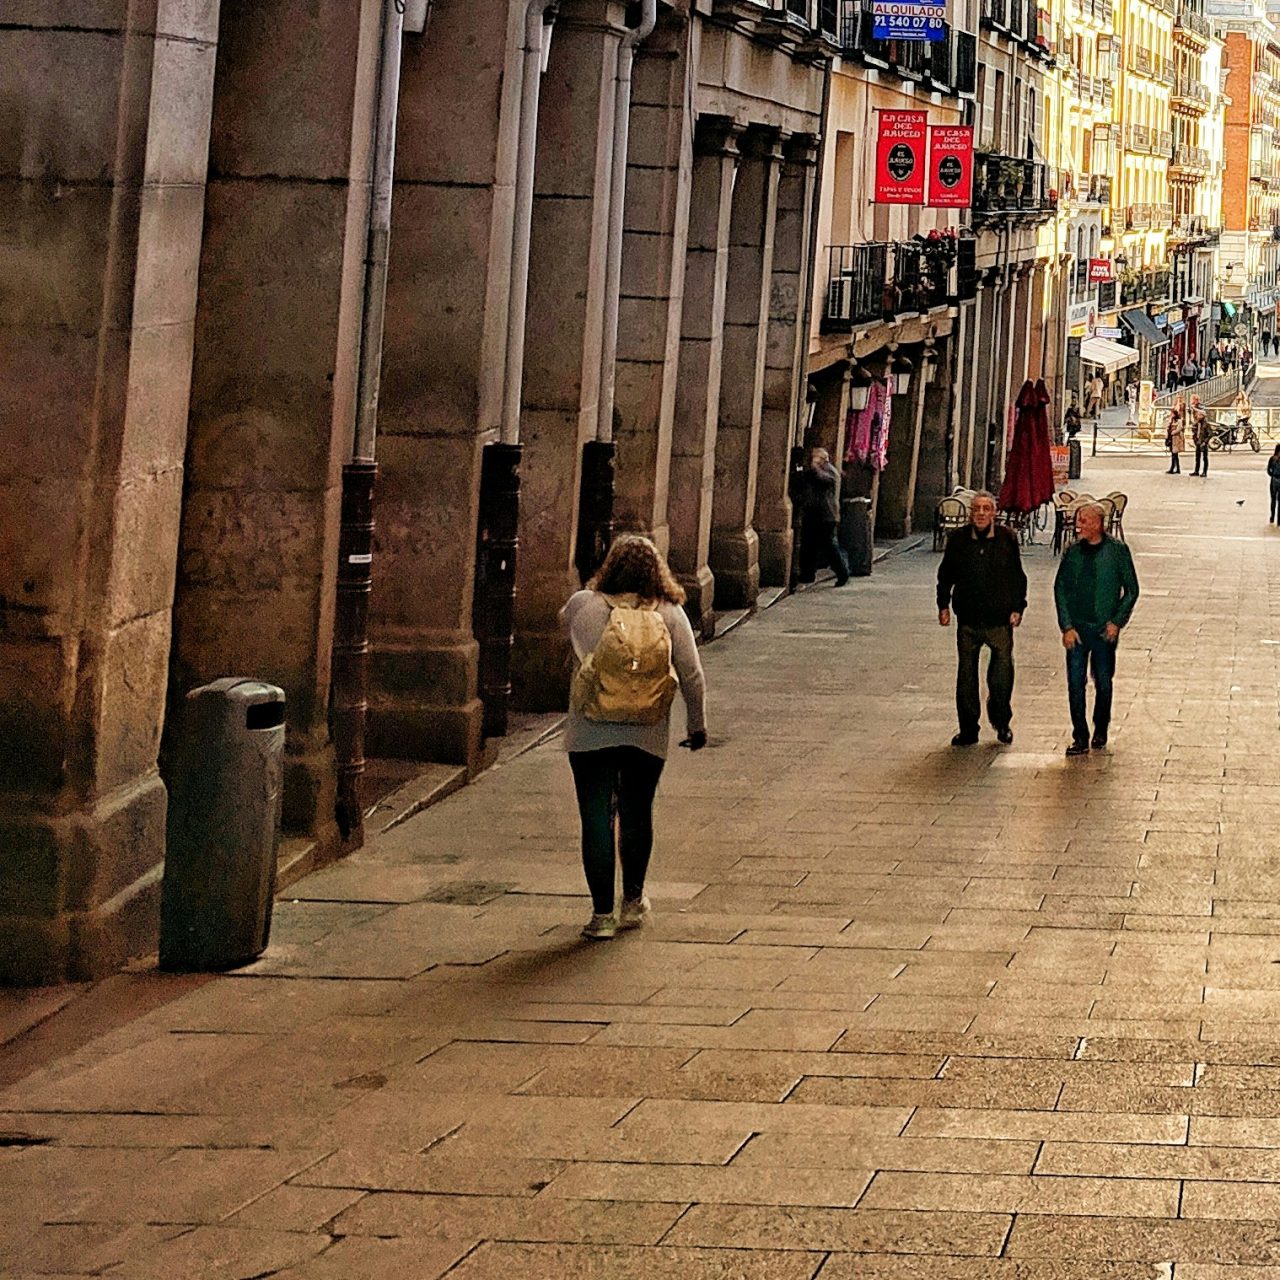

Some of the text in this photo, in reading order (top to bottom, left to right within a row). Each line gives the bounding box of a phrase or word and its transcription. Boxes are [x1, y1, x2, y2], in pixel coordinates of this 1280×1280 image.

[875, 4, 944, 17] ALQUILADO
[874, 15, 943, 29] 91 540 07 80
[897, 114, 924, 123] CASA
[946, 129, 970, 137] CASA
